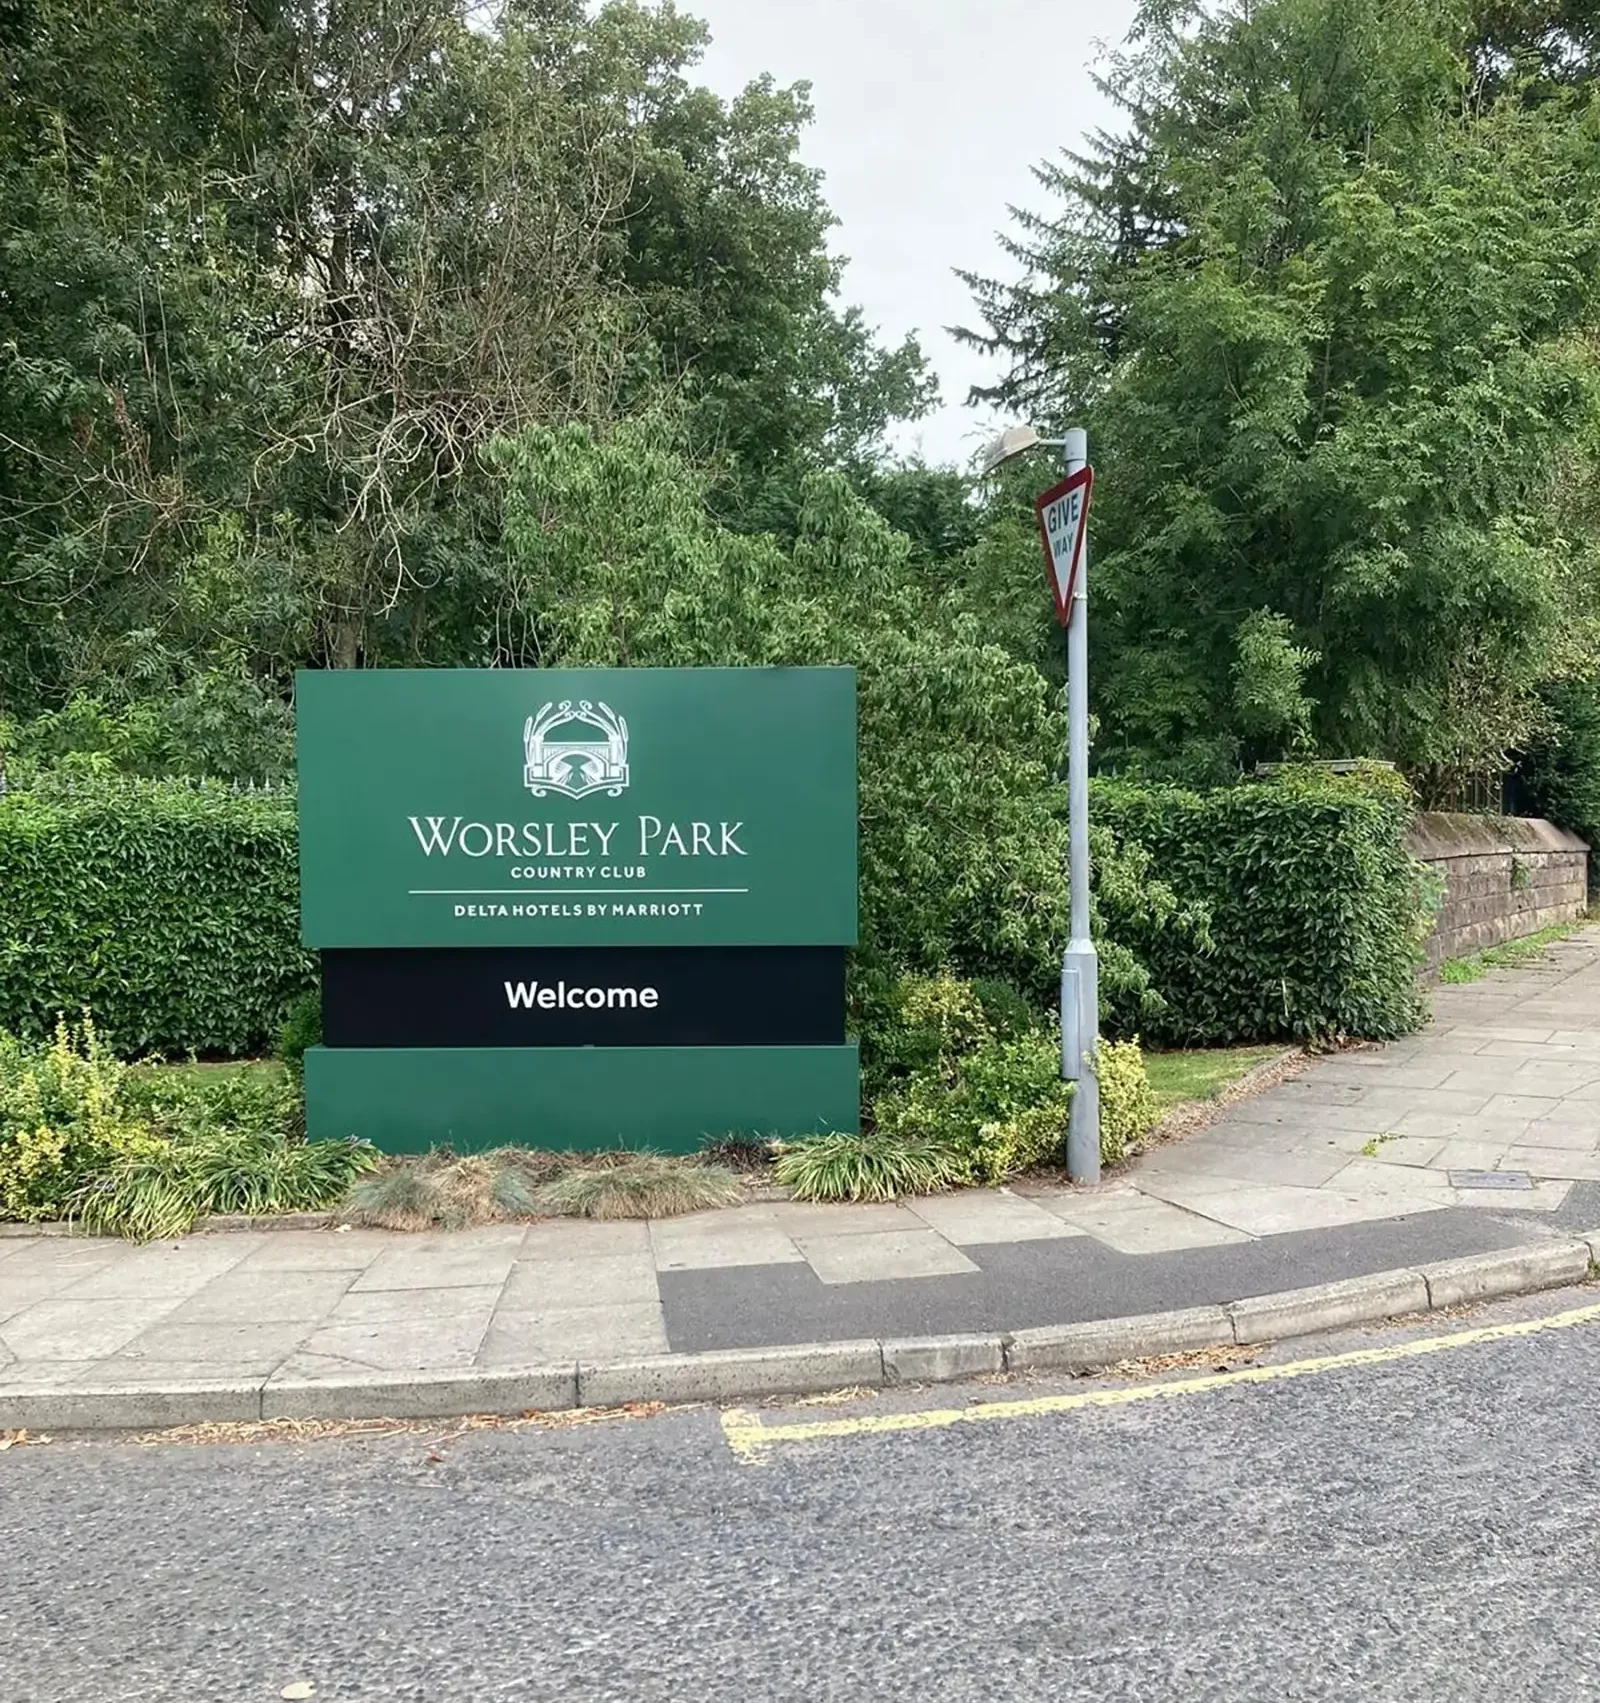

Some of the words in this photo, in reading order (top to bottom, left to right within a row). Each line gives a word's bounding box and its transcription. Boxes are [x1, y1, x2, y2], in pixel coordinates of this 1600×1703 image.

[1048, 493, 1079, 533] GIVE
[1053, 532, 1074, 559] WAY
[408, 816, 619, 857] WORSLEY
[639, 815, 749, 856] PARK
[510, 866, 596, 879] COUNTRY
[600, 866, 646, 879] CLUB
[454, 904, 509, 917] DELTA
[512, 904, 583, 917] HOTELS
[587, 904, 608, 916] BY
[612, 903, 704, 916] MARRIOTT
[504, 980, 660, 1010] Welcome
